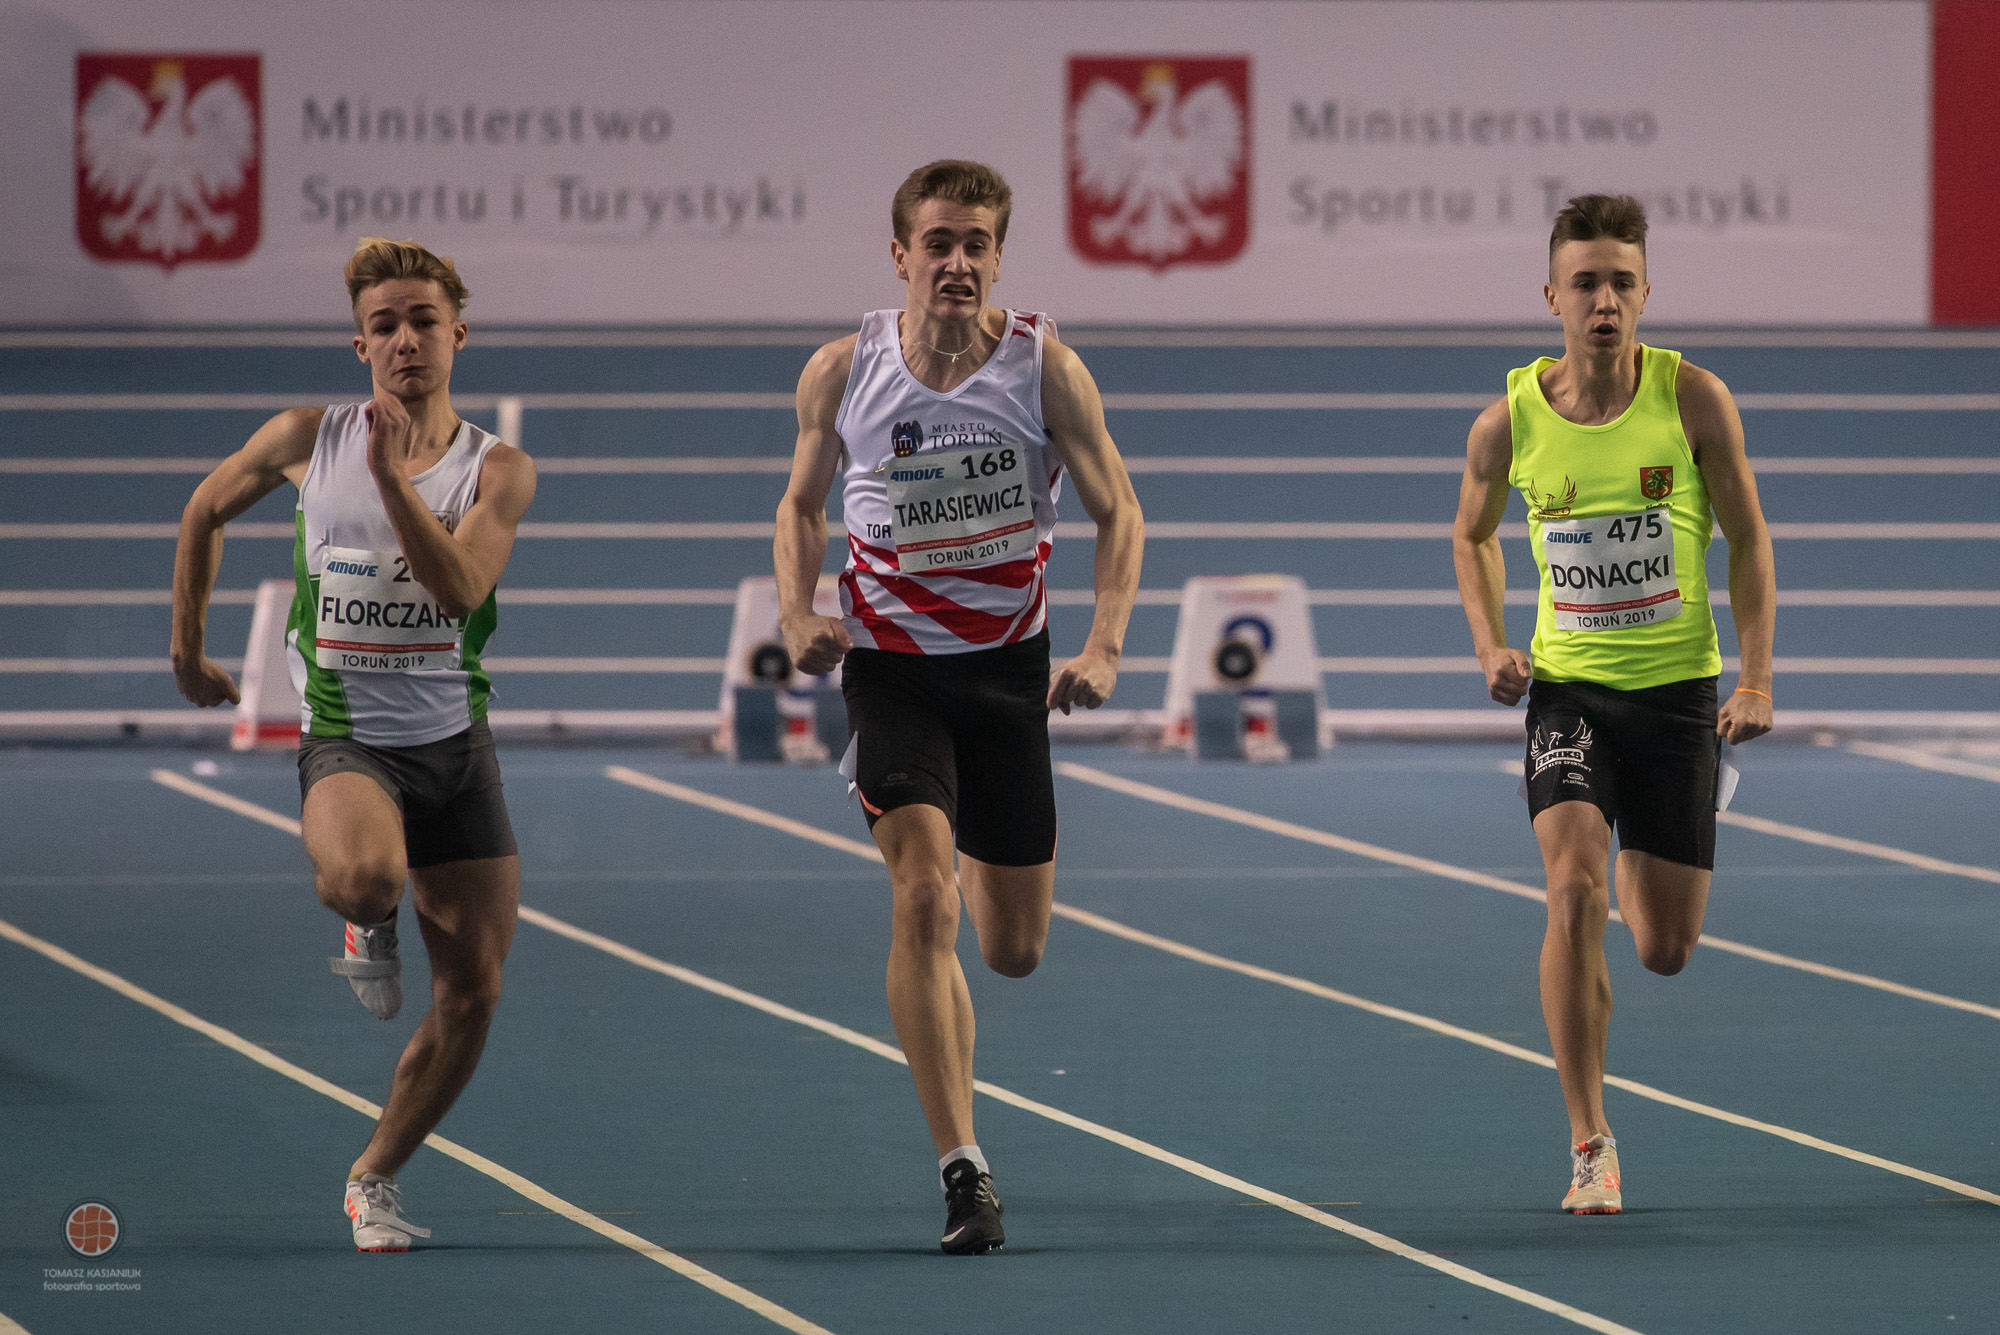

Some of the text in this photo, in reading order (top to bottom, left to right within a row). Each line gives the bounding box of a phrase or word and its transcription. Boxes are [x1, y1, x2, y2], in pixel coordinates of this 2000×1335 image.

[302, 96, 673, 144] Ministerstwo
[1289, 98, 1658, 146] Ministerstwo
[301, 174, 806, 235] Sportu i Turystyki
[1288, 175, 1790, 234] Sportu i Tstyki
[931, 423, 985, 433] MIASTO
[890, 449, 1017, 482] 4MOVE 168
[894, 484, 1025, 528] TARASIEWICZ
[1546, 513, 1663, 544] 4MOVE 475
[927, 539, 1009, 566] TORUŃ 2019
[326, 560, 378, 577] 4MOVE
[392, 556, 412, 583] 2
[1550, 554, 1670, 590] DONACKI
[1576, 609, 1656, 628] TORUŃ 2019
[341, 653, 425, 669] TORUŃ 2019
